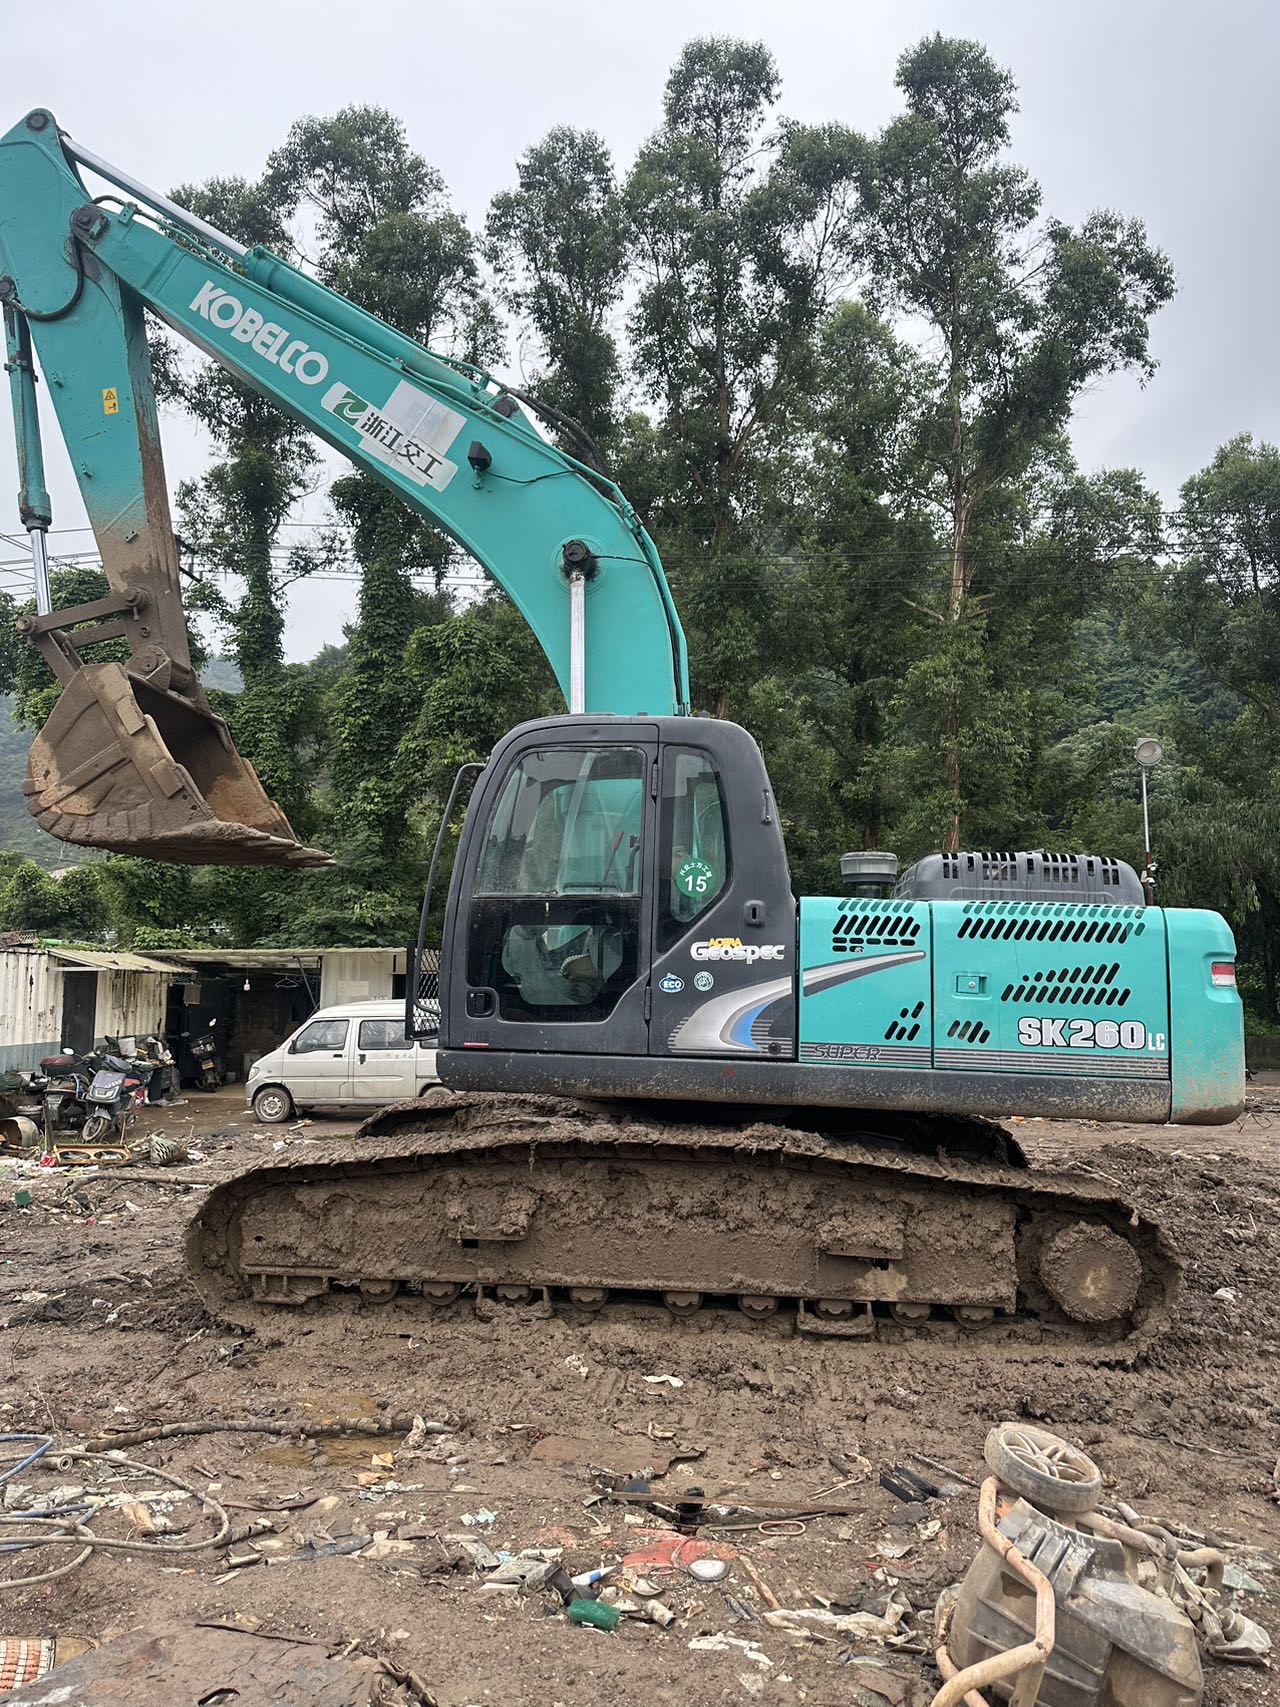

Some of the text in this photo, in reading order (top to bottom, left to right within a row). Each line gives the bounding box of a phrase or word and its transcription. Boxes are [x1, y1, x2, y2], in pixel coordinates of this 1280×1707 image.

[188, 279, 329, 385] KOBELCO
[360, 411, 443, 480] 浙江交工
[685, 874, 707, 892] 15
[690, 942, 785, 965] Geospec
[663, 980, 682, 989] ECO
[1018, 1016, 1165, 1051] SK260 LC
[814, 1044, 881, 1061] SUPER
